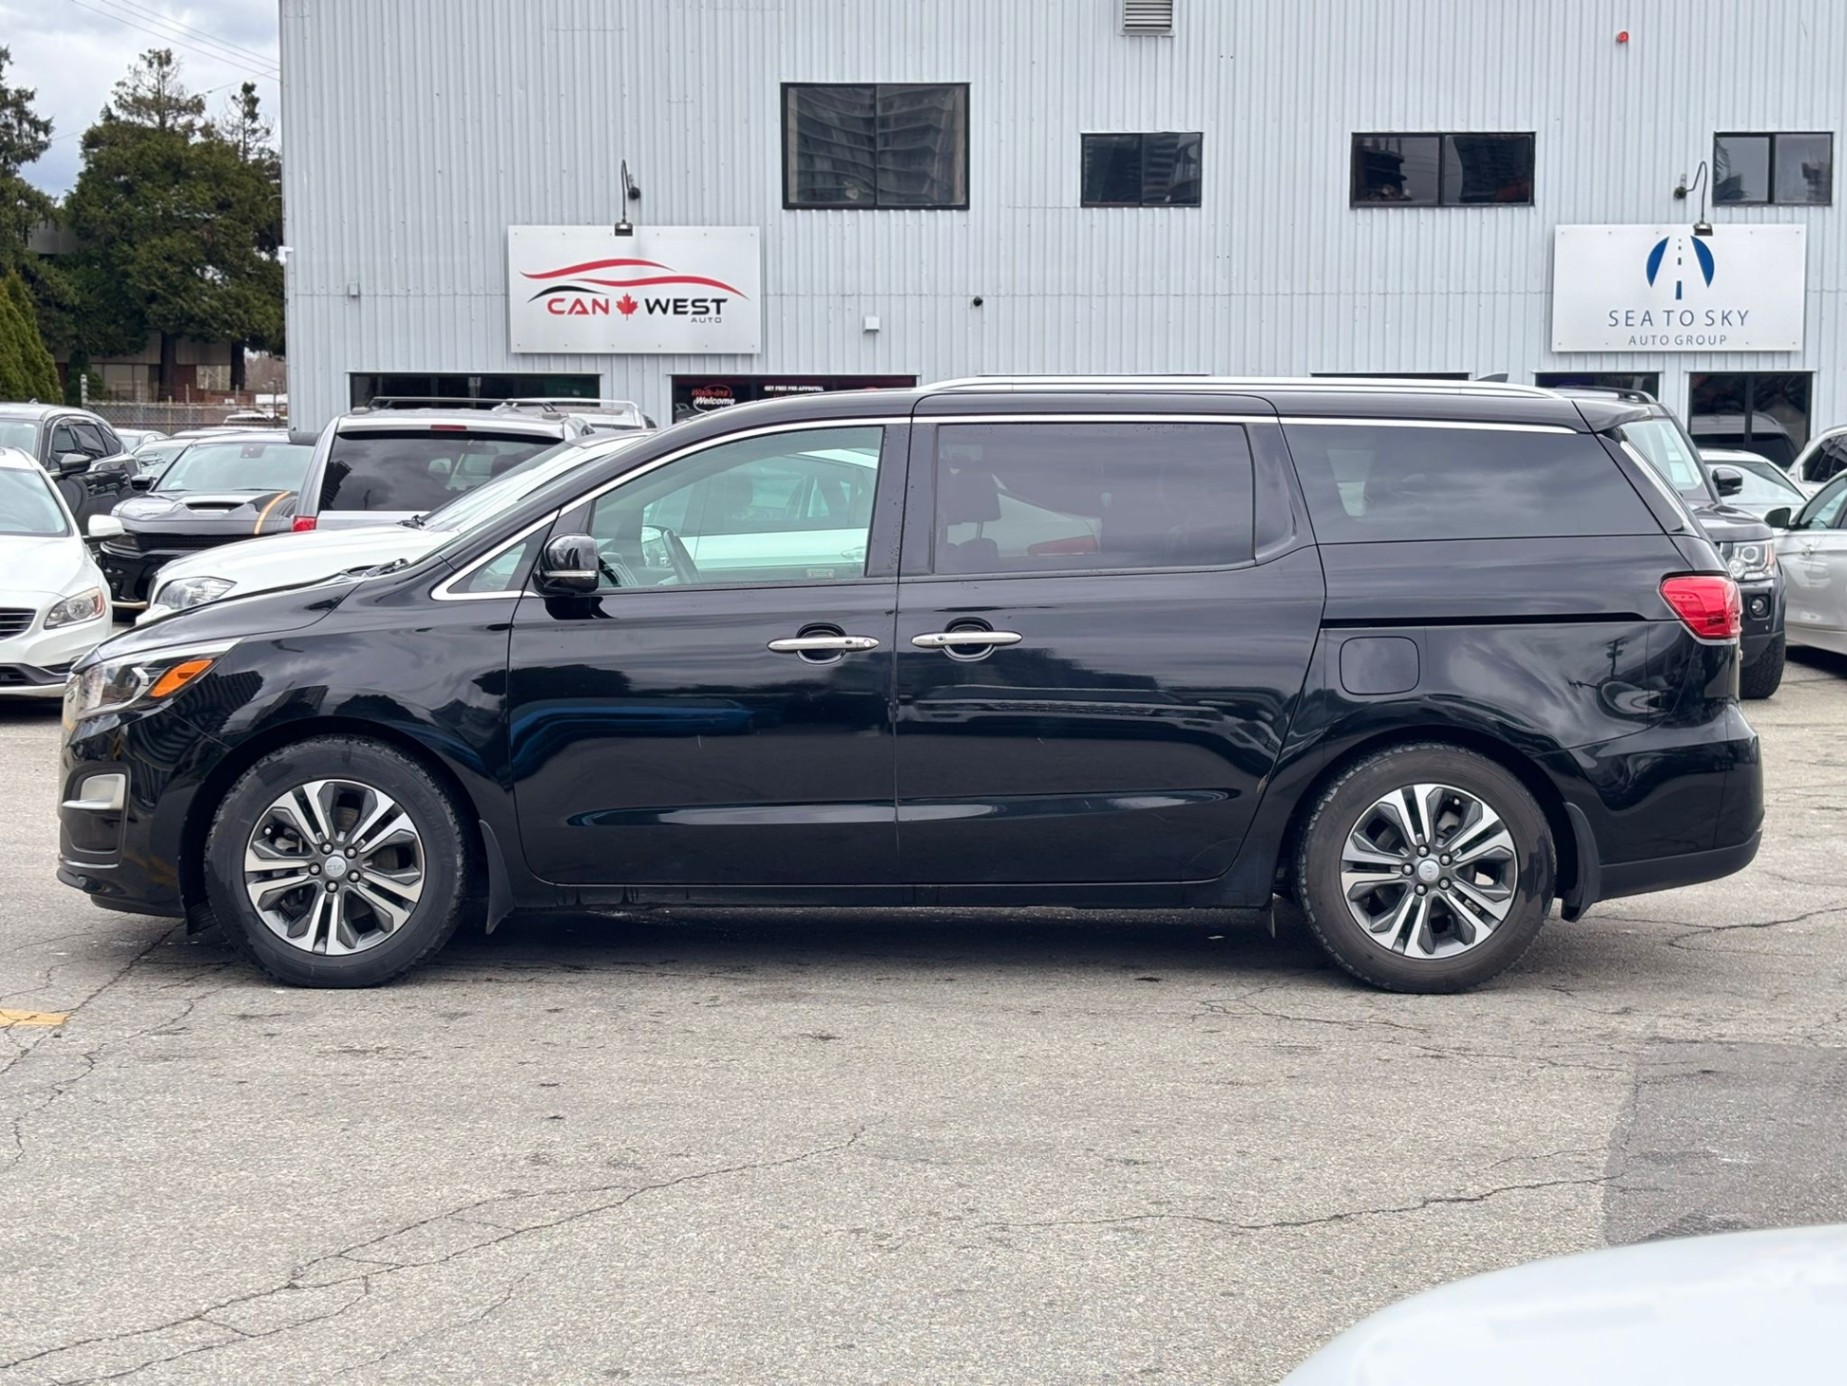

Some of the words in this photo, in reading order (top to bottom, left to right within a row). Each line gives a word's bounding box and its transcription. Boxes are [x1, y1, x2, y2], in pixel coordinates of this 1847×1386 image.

[547, 298, 610, 315] CAN
[644, 298, 728, 315] WEST
[1608, 310, 1654, 327] SEA
[1663, 310, 1695, 327] TO
[1704, 310, 1749, 327] SKY
[1628, 335, 1669, 346] AUTO
[1674, 335, 1727, 346] GROUP
[695, 396, 735, 405] Welcome
